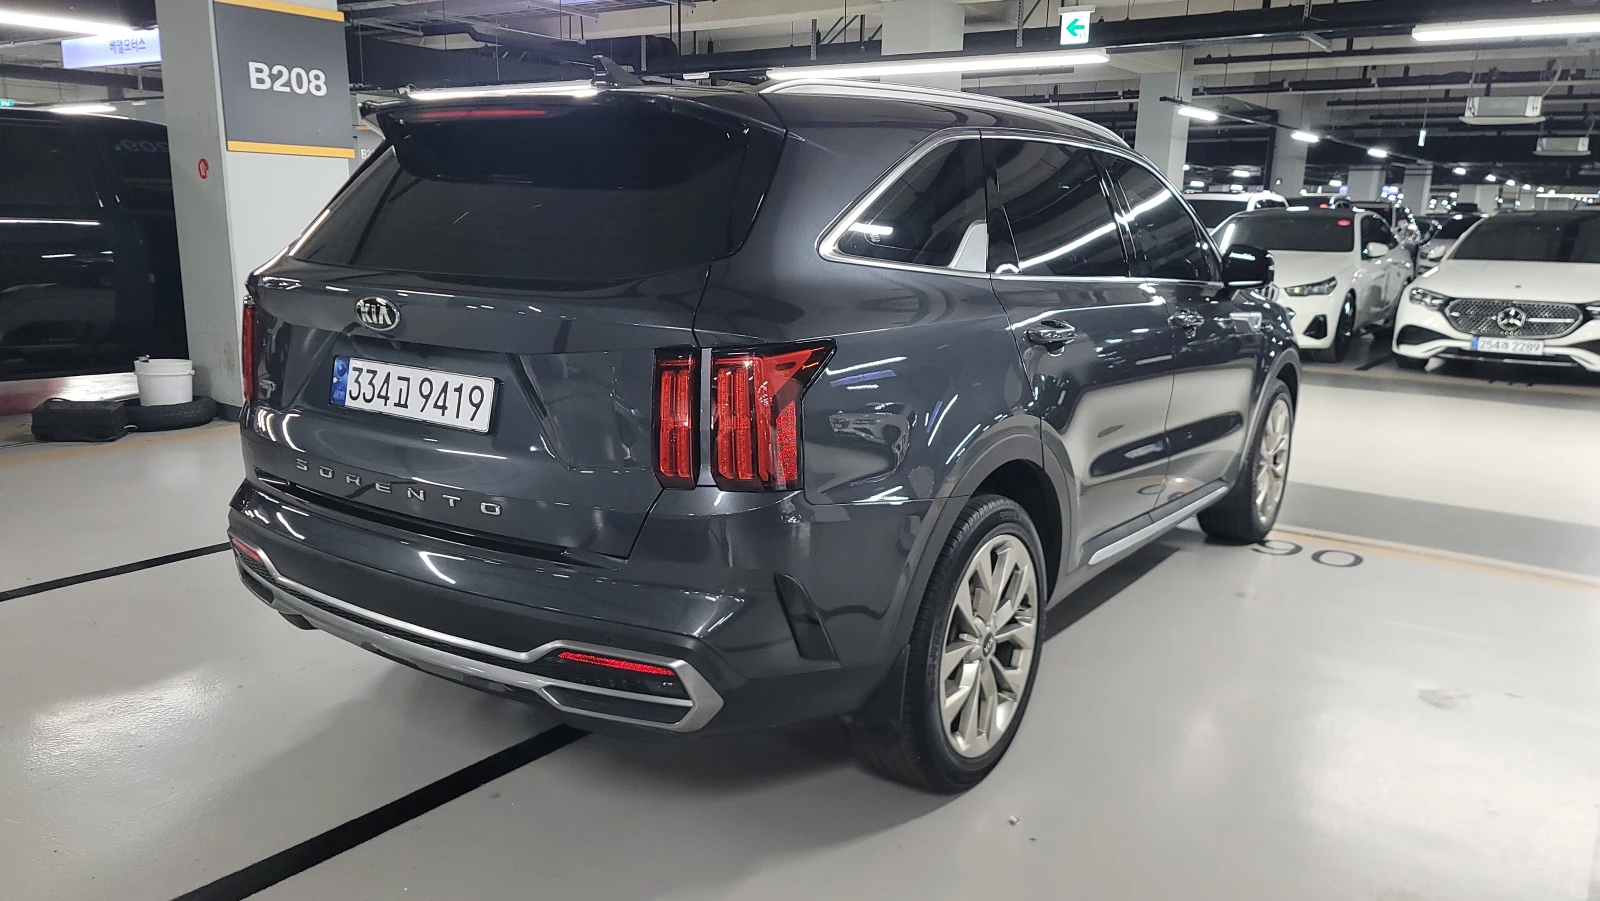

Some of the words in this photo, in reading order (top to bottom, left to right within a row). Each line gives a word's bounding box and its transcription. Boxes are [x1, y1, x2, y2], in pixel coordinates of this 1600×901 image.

[248, 61, 328, 96] B208
[361, 148, 375, 159] B2
[360, 303, 392, 325] KIA
[349, 366, 411, 410] 334고
[418, 377, 485, 422] 9419
[295, 458, 504, 517] SORENTO
